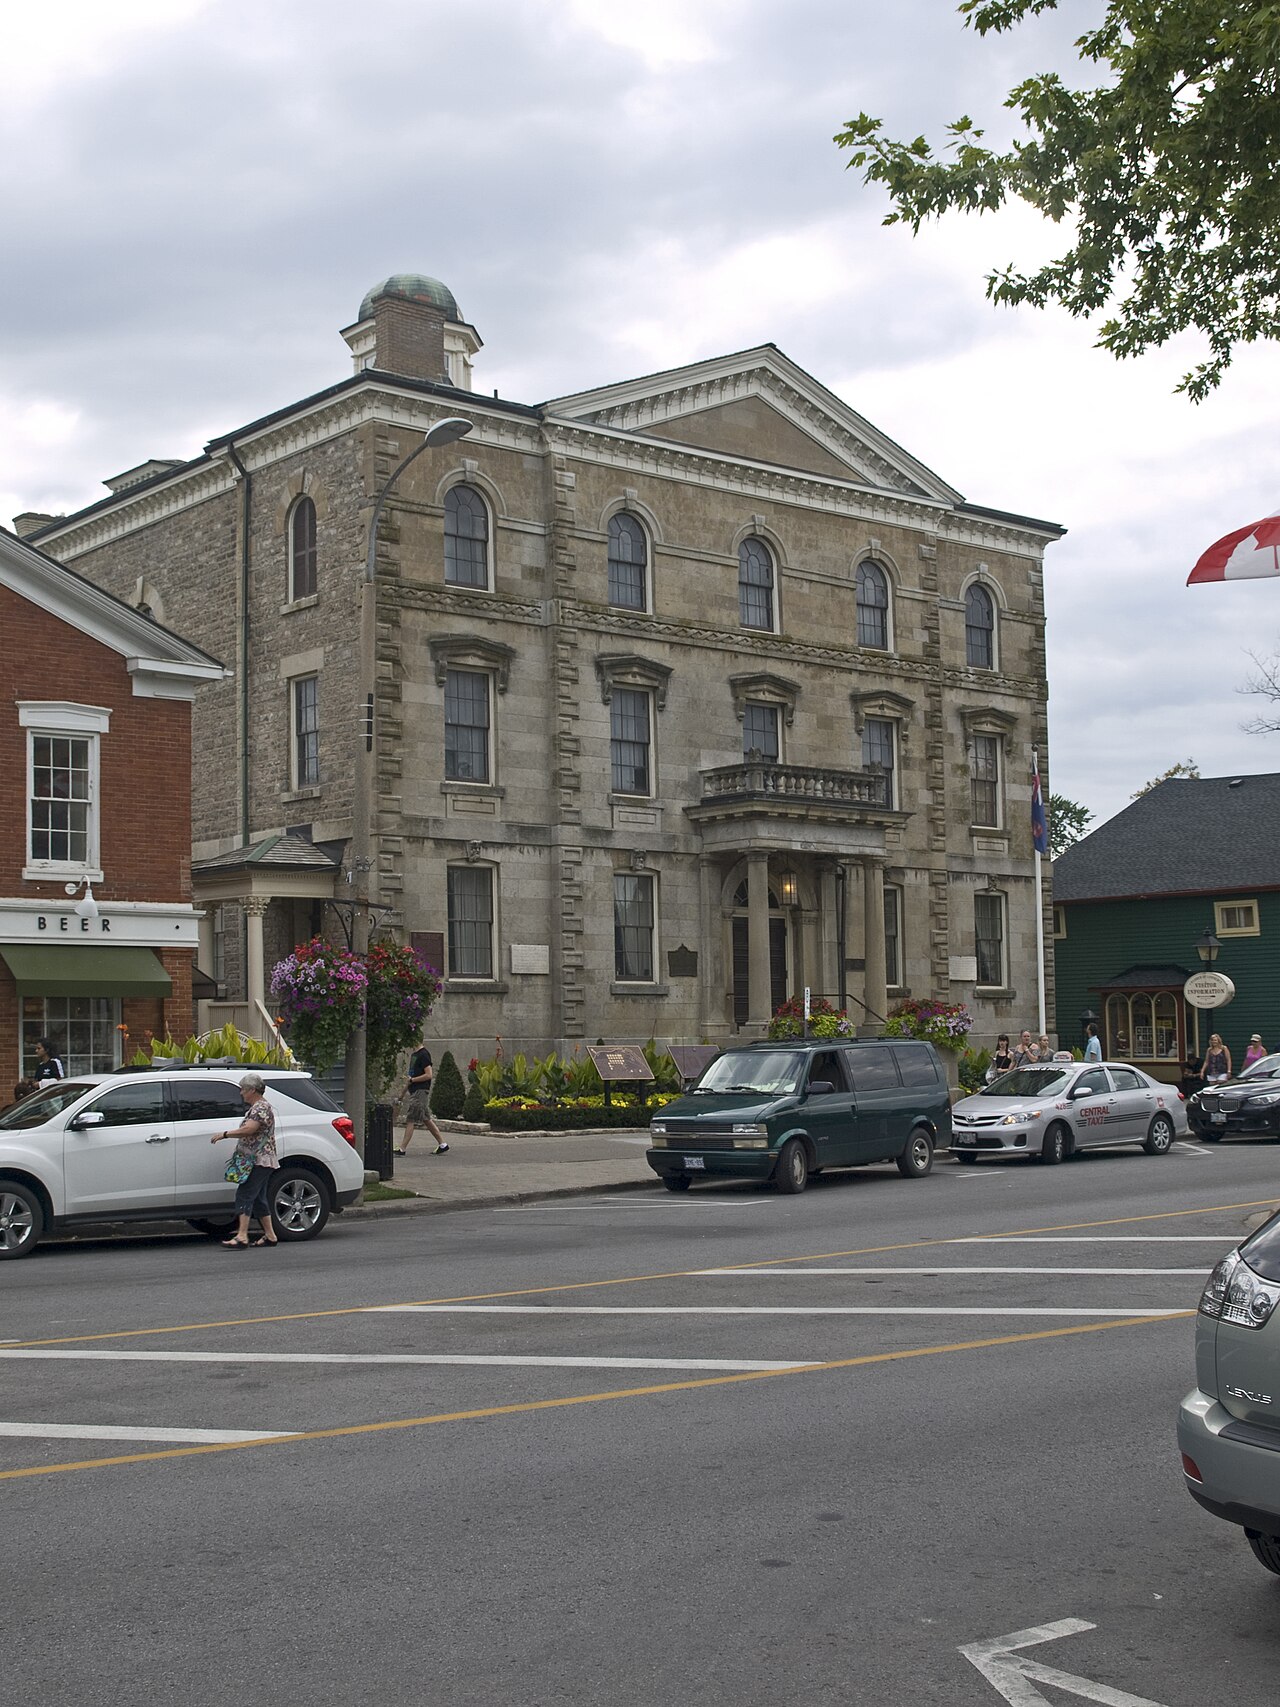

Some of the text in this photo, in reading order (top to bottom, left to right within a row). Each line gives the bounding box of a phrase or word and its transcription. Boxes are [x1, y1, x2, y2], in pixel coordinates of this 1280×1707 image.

[38, 916, 111, 932] BEER
[1080, 1106, 1110, 1117] CENTRAL
[1087, 1116, 1104, 1126] TAXI
[1225, 1384, 1272, 1405] LEXUS
